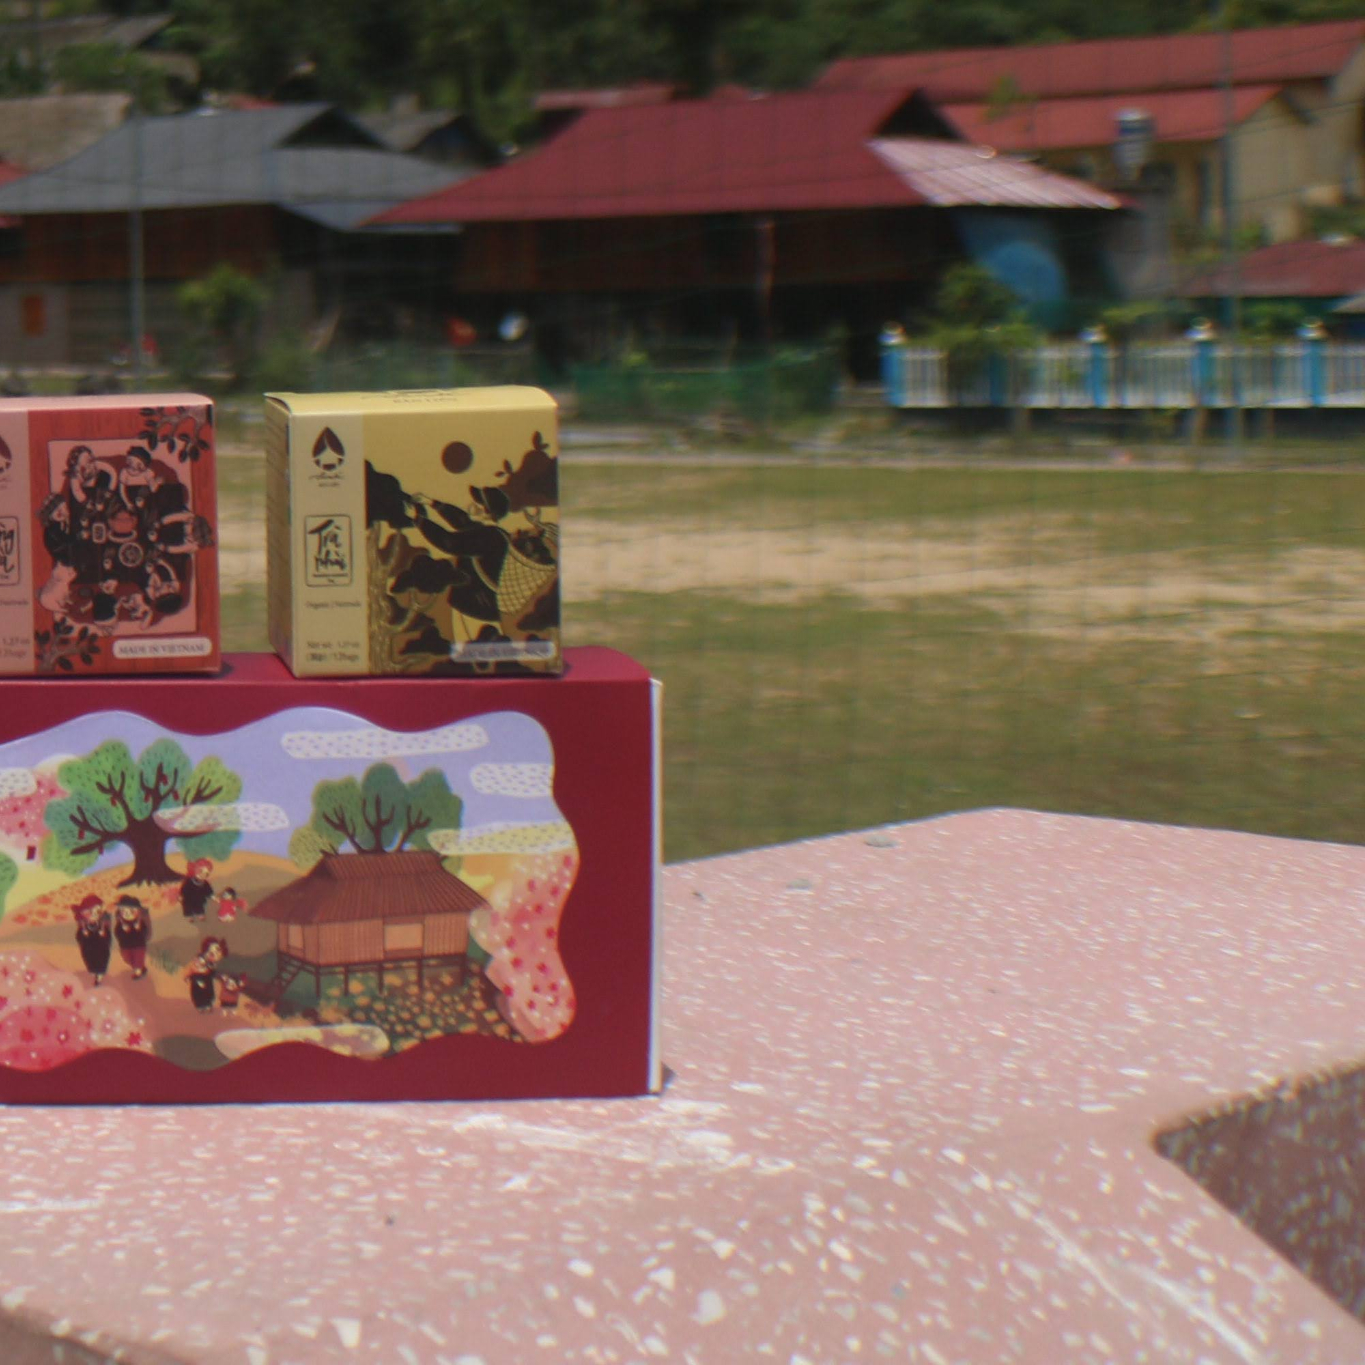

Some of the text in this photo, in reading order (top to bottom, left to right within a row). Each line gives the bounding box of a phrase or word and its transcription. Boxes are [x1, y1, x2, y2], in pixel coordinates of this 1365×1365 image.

[308, 519, 342, 555] Trà
[119, 645, 147, 654] MADE
[149, 644, 160, 654] IN
